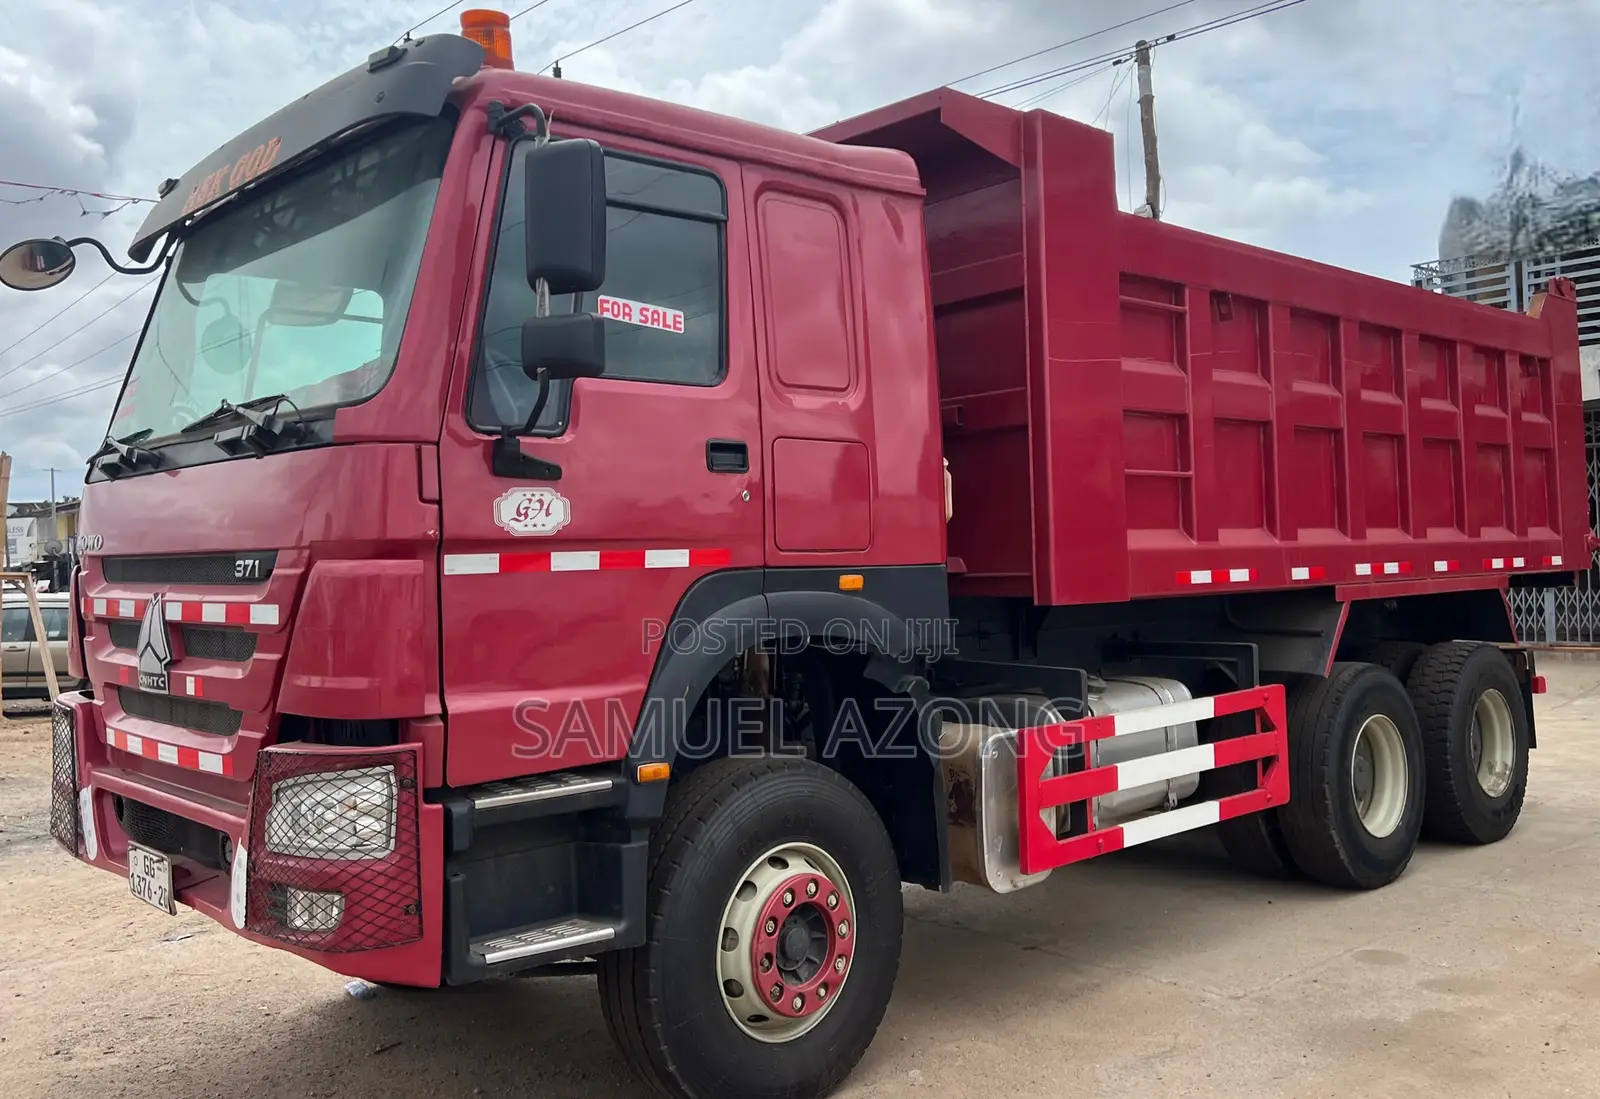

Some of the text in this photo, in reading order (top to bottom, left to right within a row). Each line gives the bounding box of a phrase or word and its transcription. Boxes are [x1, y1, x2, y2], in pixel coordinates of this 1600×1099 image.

[600, 299, 682, 332] FOR SALE
[235, 559, 260, 578] 371
[140, 674, 165, 687] CNHTC
